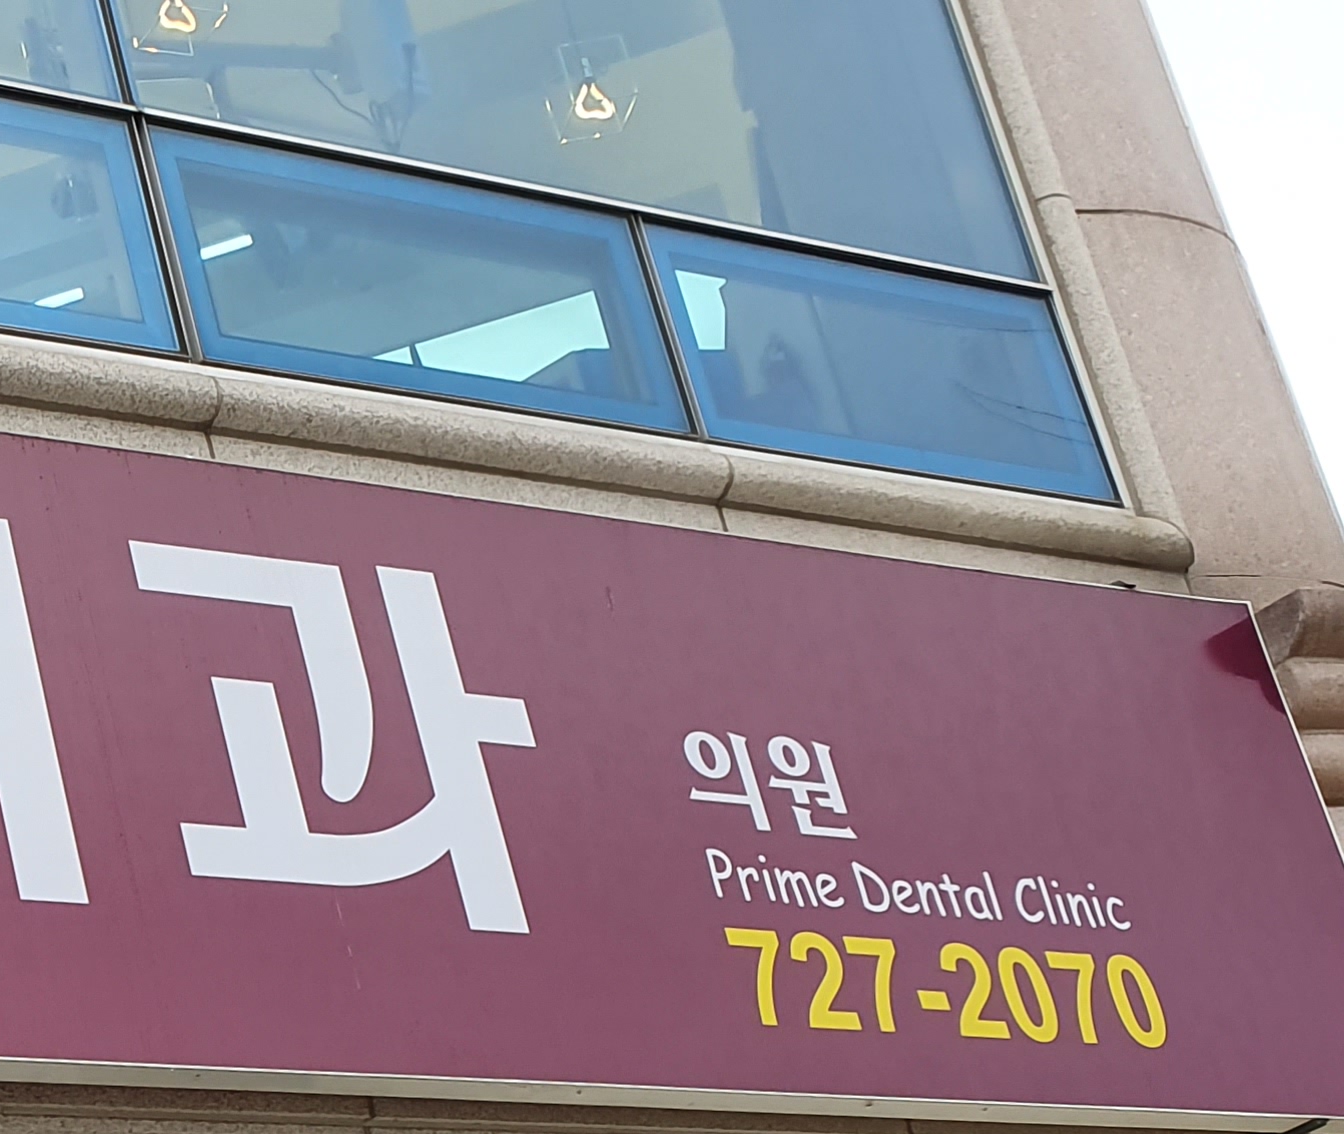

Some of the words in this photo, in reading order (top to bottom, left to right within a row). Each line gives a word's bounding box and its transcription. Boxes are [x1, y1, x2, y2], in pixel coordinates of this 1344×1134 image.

[683, 730, 858, 839] 의원
[705, 847, 845, 907] Prime
[851, 861, 1003, 921] Dental
[1015, 876, 1132, 931] Clinic
[724, 926, 1168, 1048] 727-2070
